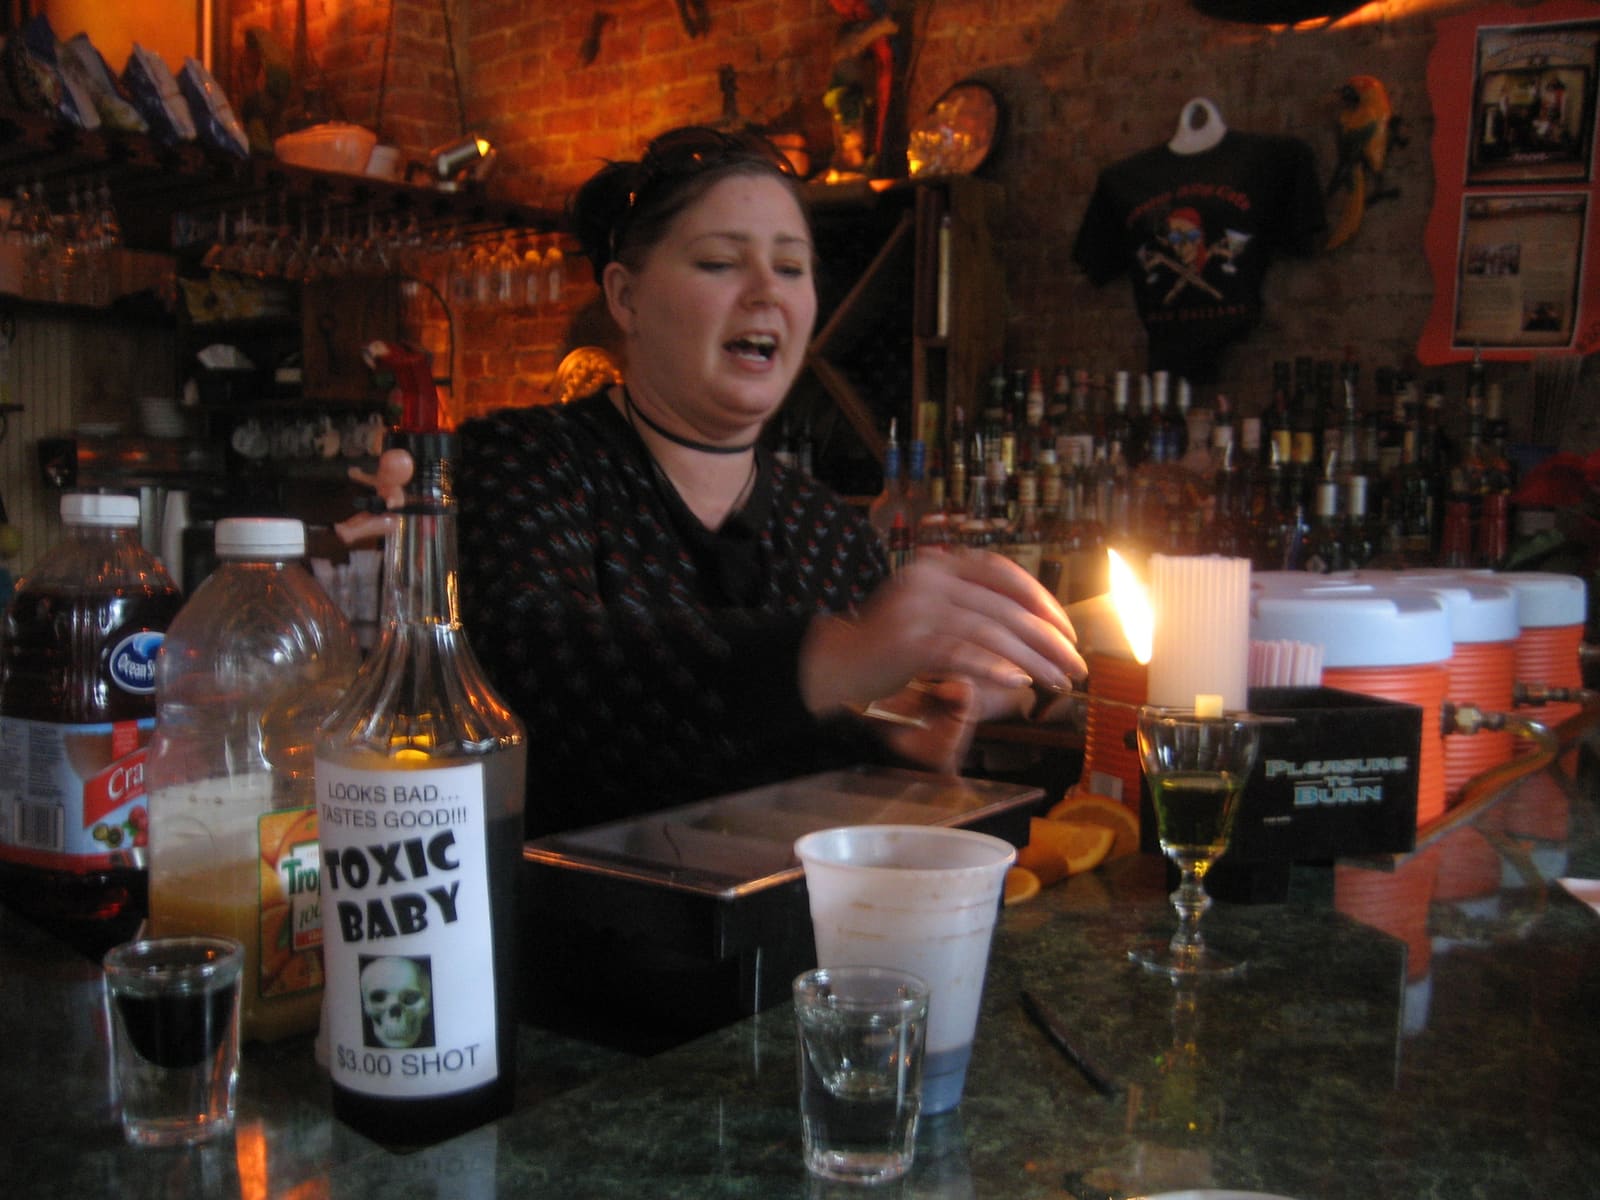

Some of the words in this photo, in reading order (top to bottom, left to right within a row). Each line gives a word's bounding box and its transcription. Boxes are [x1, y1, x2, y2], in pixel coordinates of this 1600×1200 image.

[118, 653, 147, 681] Ocean
[108, 762, 145, 800] Cra
[328, 782, 387, 801] LOOKS
[393, 784, 460, 803] BAD...
[1294, 786, 1382, 806] BURN
[322, 804, 377, 827] TASTES
[383, 807, 467, 828] GOOD!!!
[323, 828, 460, 890] TOXIC
[281, 858, 321, 896] Tro
[337, 879, 460, 943] BABY
[337, 1044, 392, 1076] $3.00
[401, 1044, 480, 1076] SHOT
